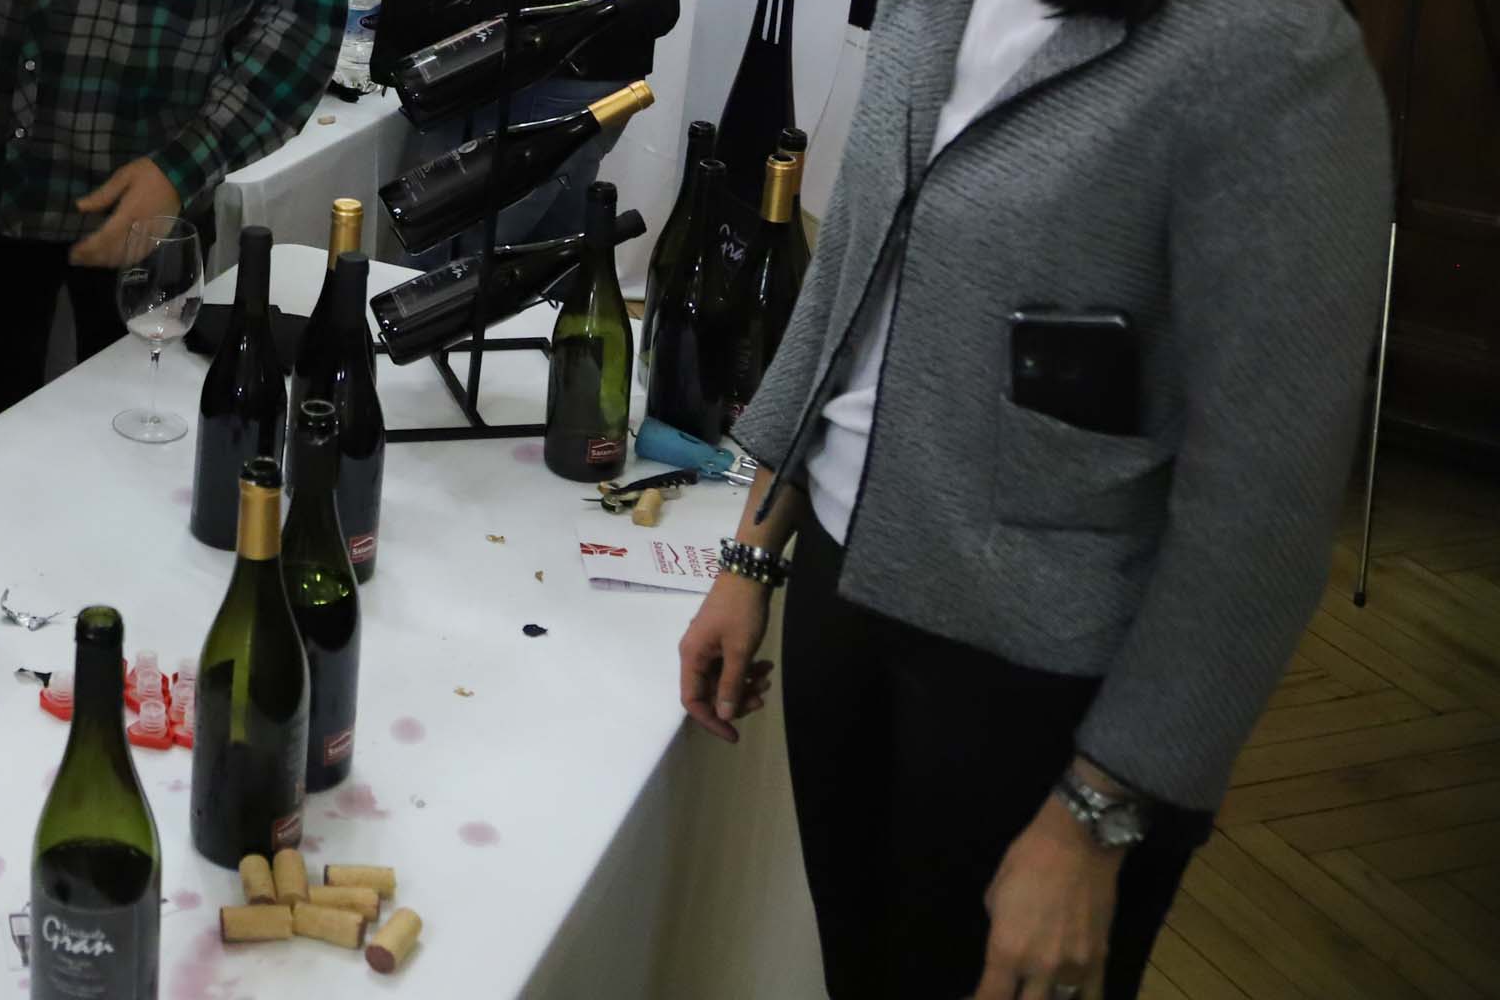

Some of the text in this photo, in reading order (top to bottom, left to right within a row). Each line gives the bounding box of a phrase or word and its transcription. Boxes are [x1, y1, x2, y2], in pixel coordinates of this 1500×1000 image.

[684, 545, 703, 578] BODEGAS
[700, 547, 722, 580] VINOS
[42, 914, 114, 957] Gran
